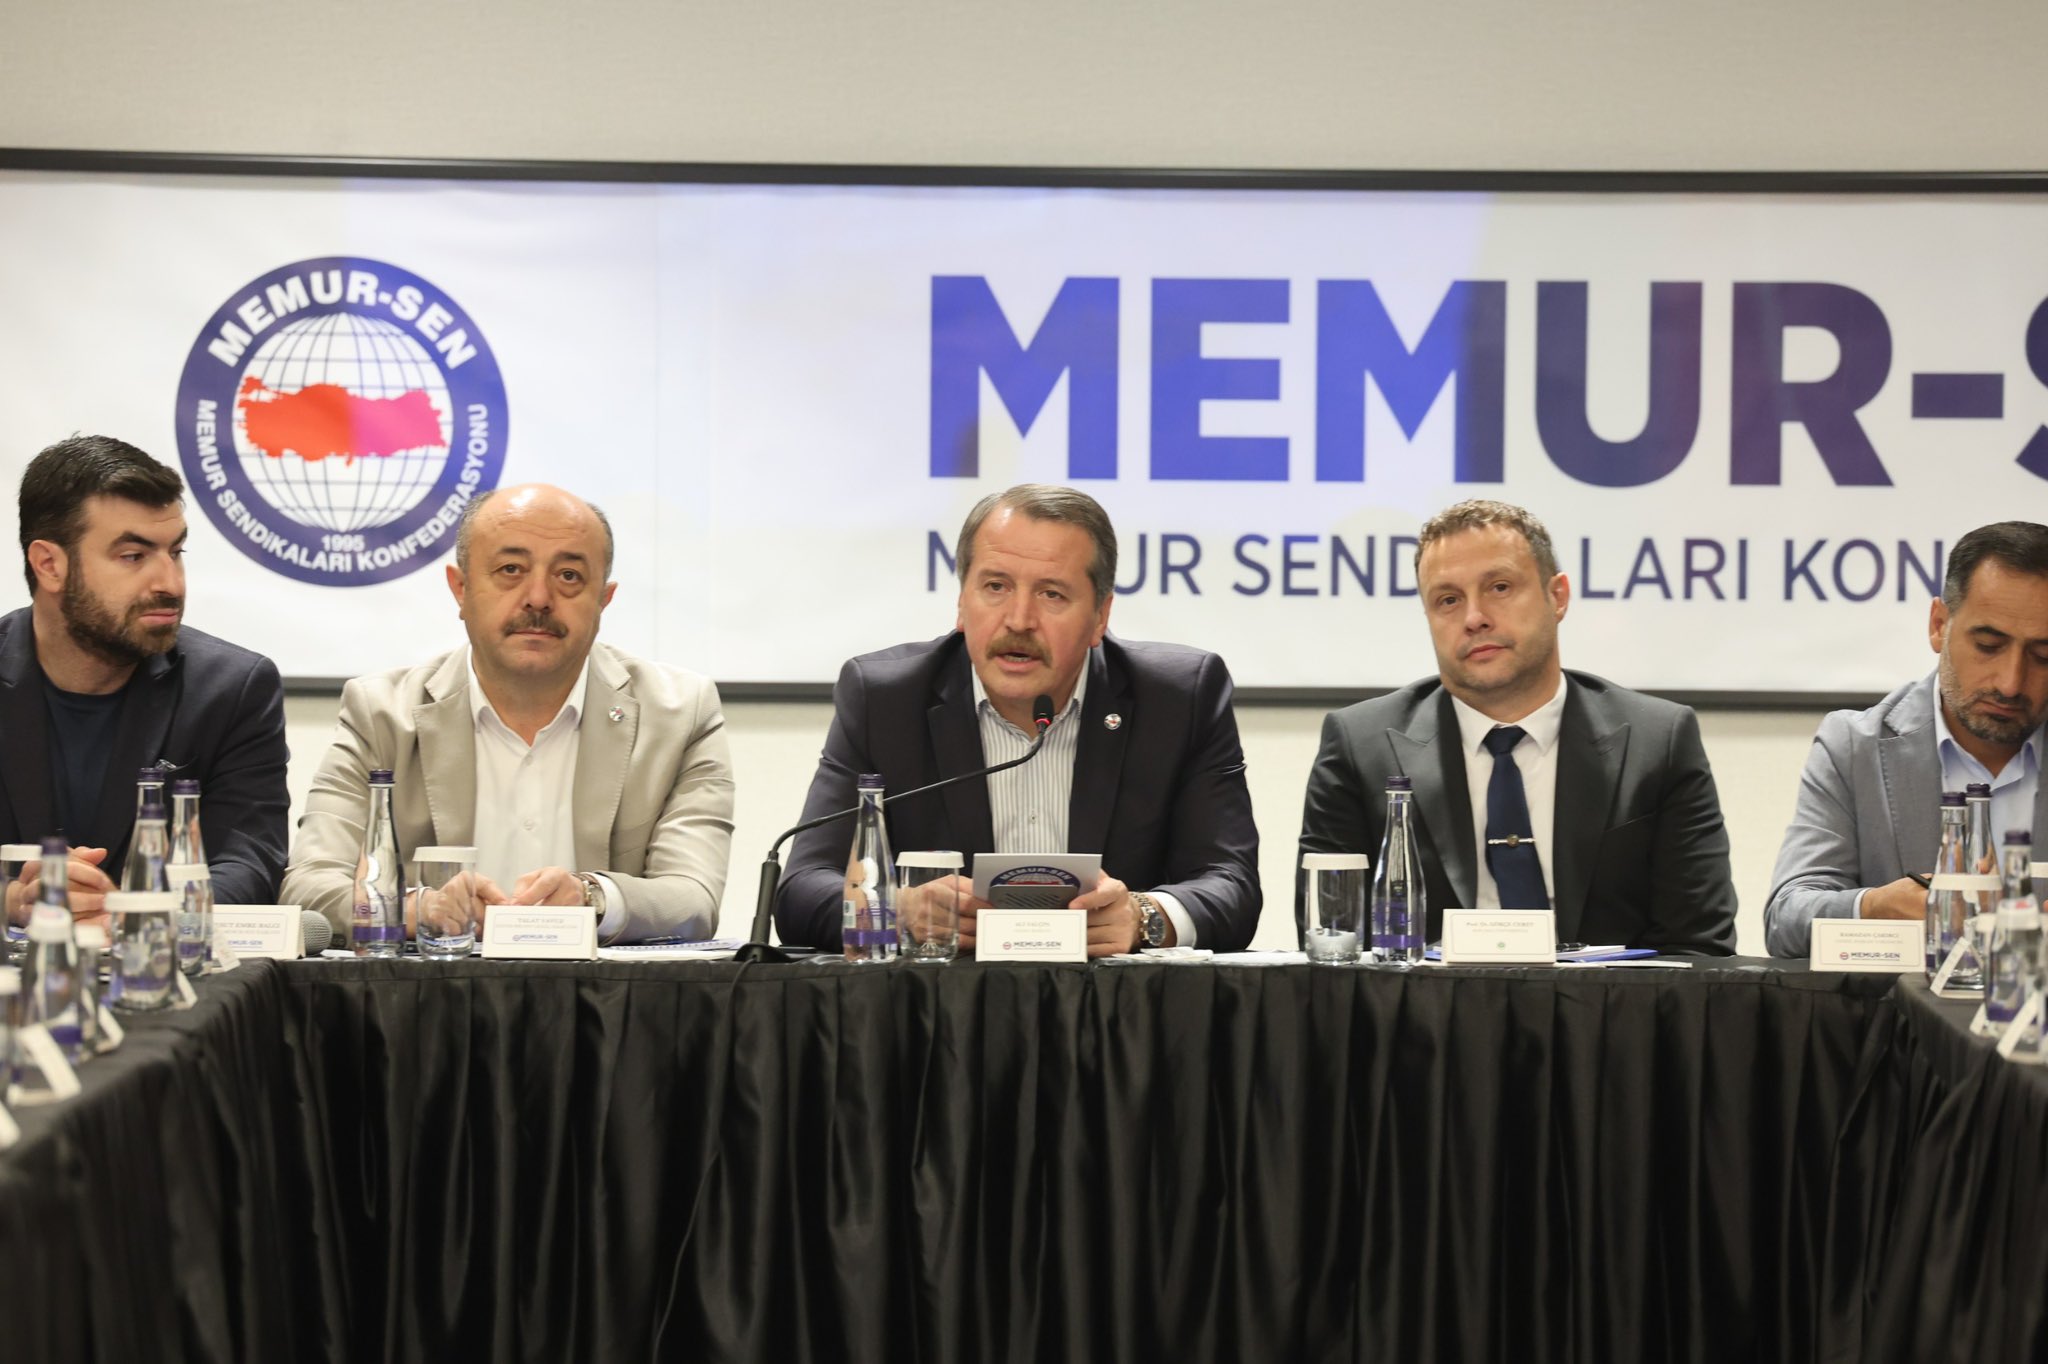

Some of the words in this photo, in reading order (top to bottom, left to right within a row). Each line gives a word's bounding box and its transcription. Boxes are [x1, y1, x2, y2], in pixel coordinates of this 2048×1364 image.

[208, 270, 477, 369] MEMUR-SEN
[928, 275, 2048, 488] MEMUR-
[196, 399, 227, 491] MEMUR
[357, 403, 489, 572] KONFEDERASYONU
[927, 530, 1202, 596] MUR
[1232, 533, 1747, 601] SENDLARI
[1000, 867, 1073, 881] MEMUR-SEN
